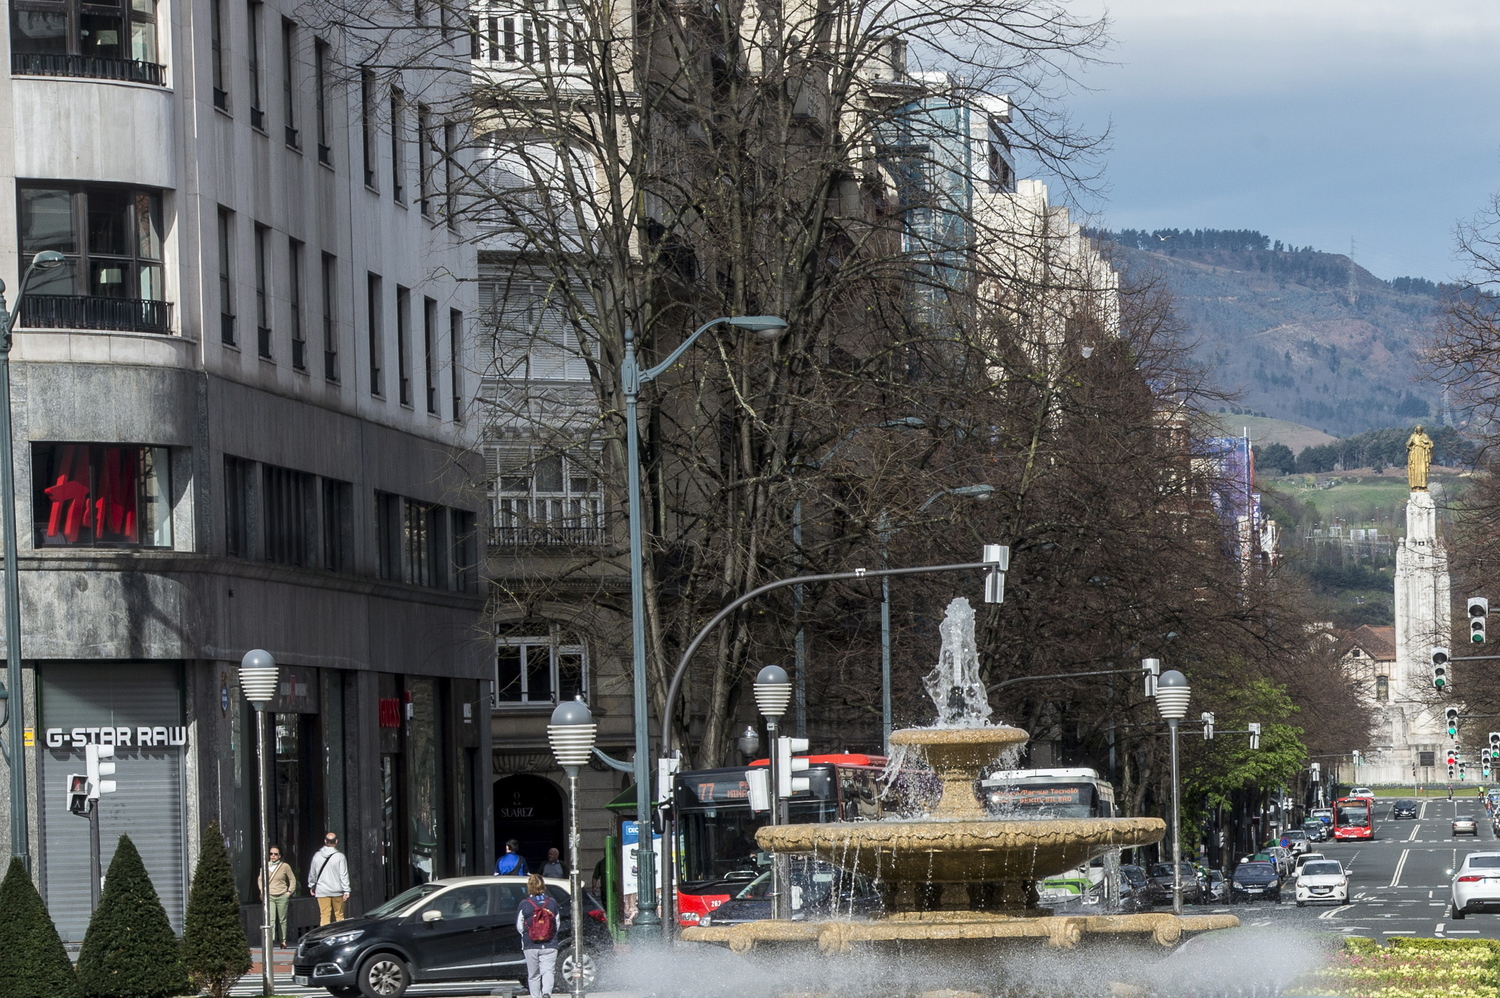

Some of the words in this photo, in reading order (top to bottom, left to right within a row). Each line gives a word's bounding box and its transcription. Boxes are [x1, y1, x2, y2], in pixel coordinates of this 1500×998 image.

[46, 726, 132, 747] G-STAR
[137, 726, 186, 746] RAW
[698, 783, 715, 800] 77
